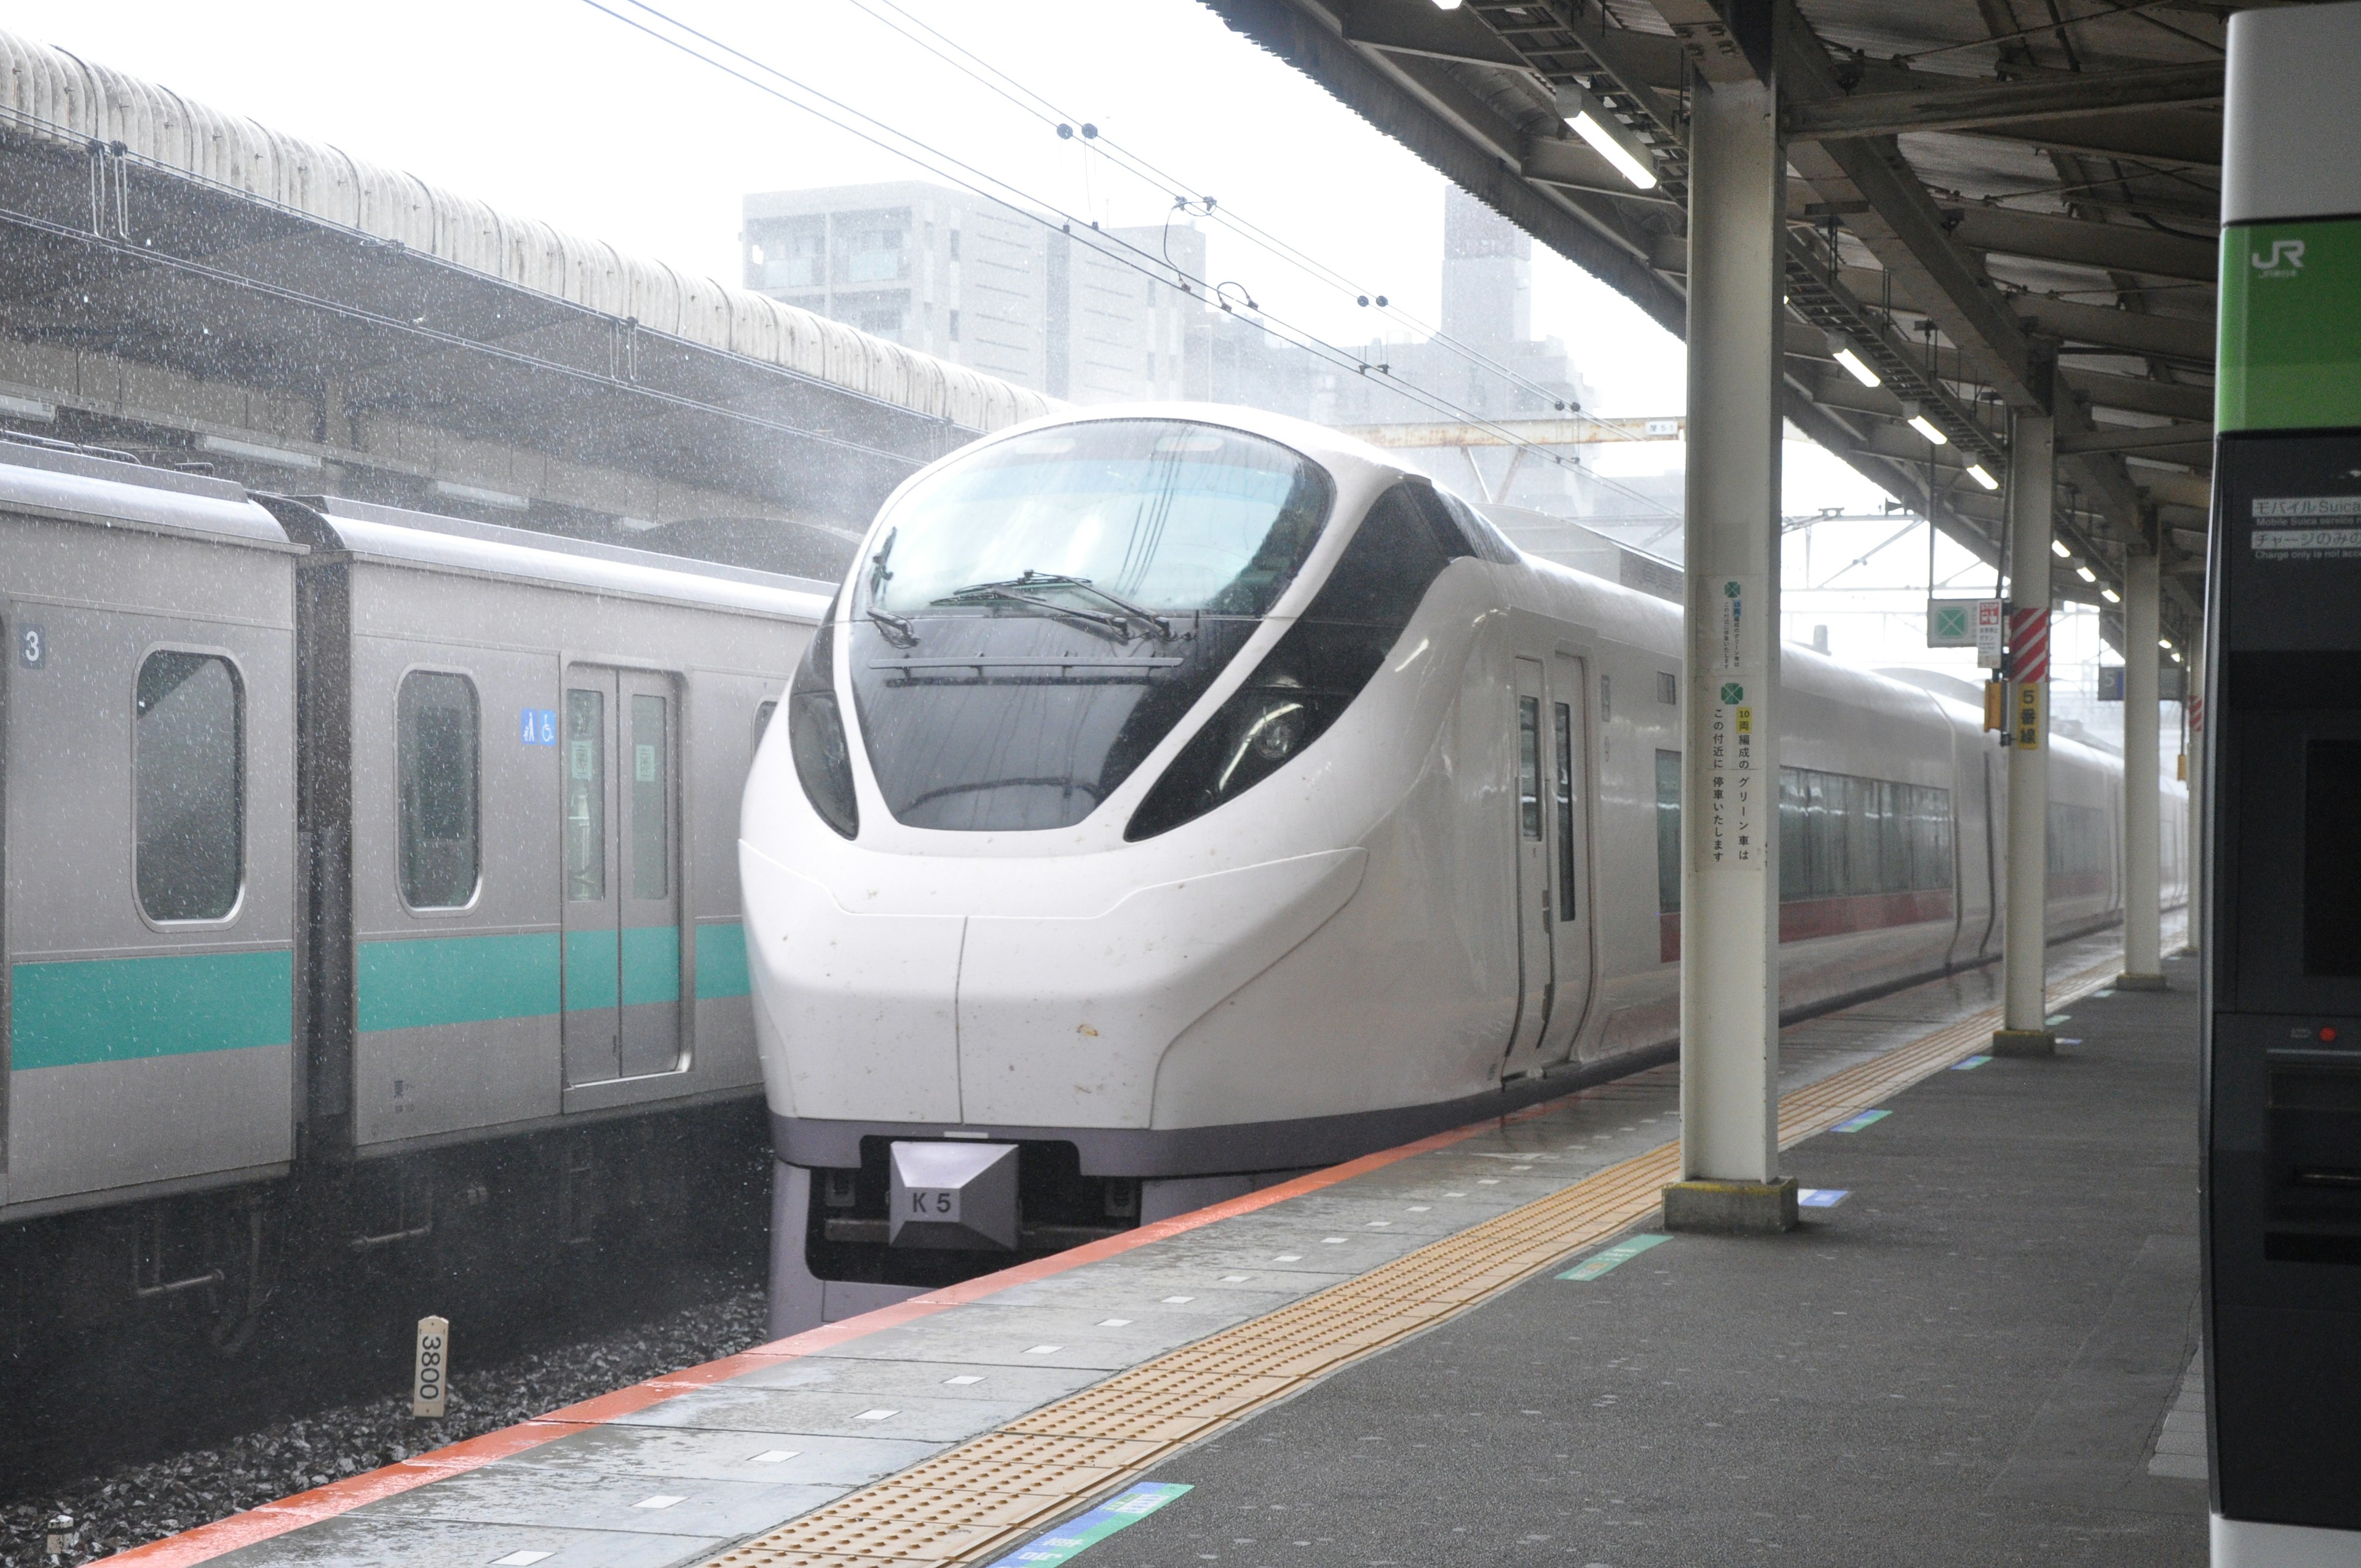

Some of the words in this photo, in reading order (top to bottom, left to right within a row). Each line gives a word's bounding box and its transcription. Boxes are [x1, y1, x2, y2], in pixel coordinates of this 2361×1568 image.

[2252, 240, 2305, 269] JR
[2256, 517, 2288, 526] Mobile
[2290, 517, 2317, 526] Suica
[2255, 550, 2288, 561] Charge
[2291, 550, 2311, 560] only
[2314, 550, 2322, 558] is
[2325, 550, 2341, 558] not
[26, 631, 39, 662] 3
[2021, 689, 2036, 744] 5番線
[1713, 708, 1724, 861] この付近に停車いたします
[420, 1335, 441, 1400] 3800
